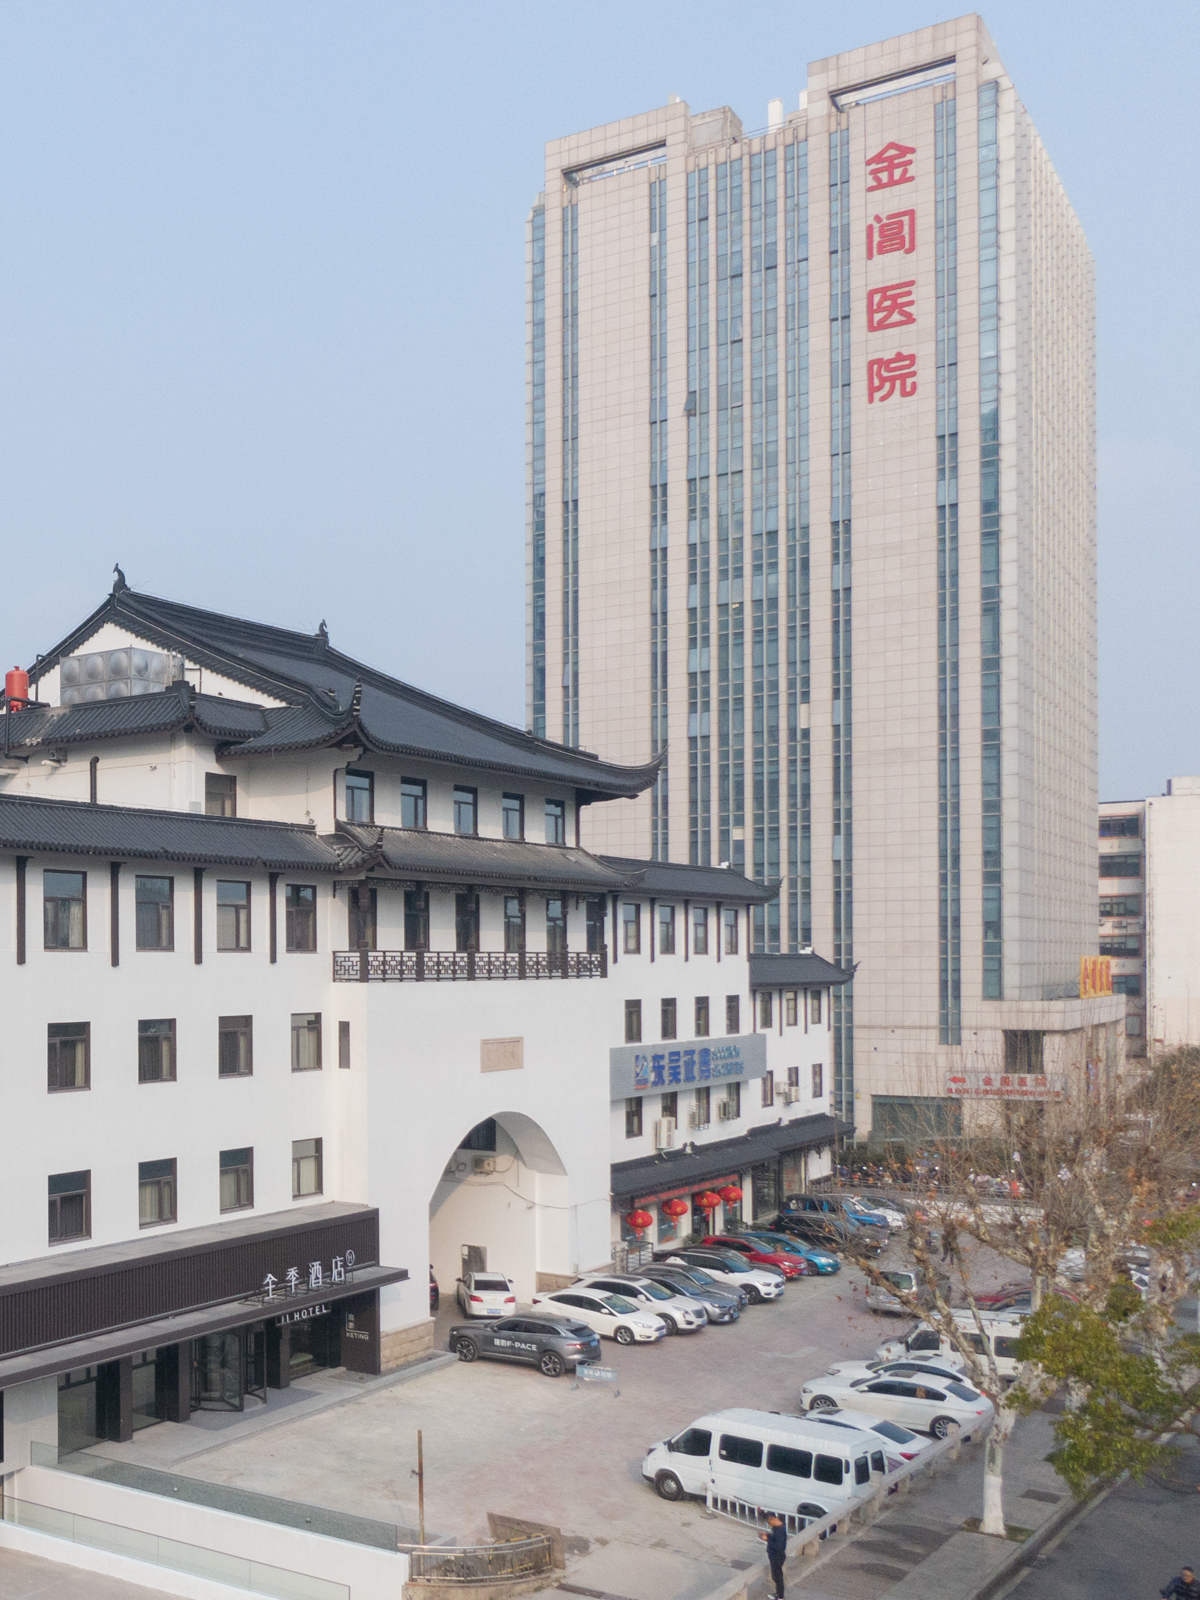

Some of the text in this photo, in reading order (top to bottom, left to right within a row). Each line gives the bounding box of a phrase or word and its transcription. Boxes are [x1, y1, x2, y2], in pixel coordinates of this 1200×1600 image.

[865, 141, 917, 404] 金阊医院
[651, 1047, 711, 1087] 东吴证券
[263, 1255, 346, 1300] 全季酒店
[294, 1304, 327, 1321] HOTEL
